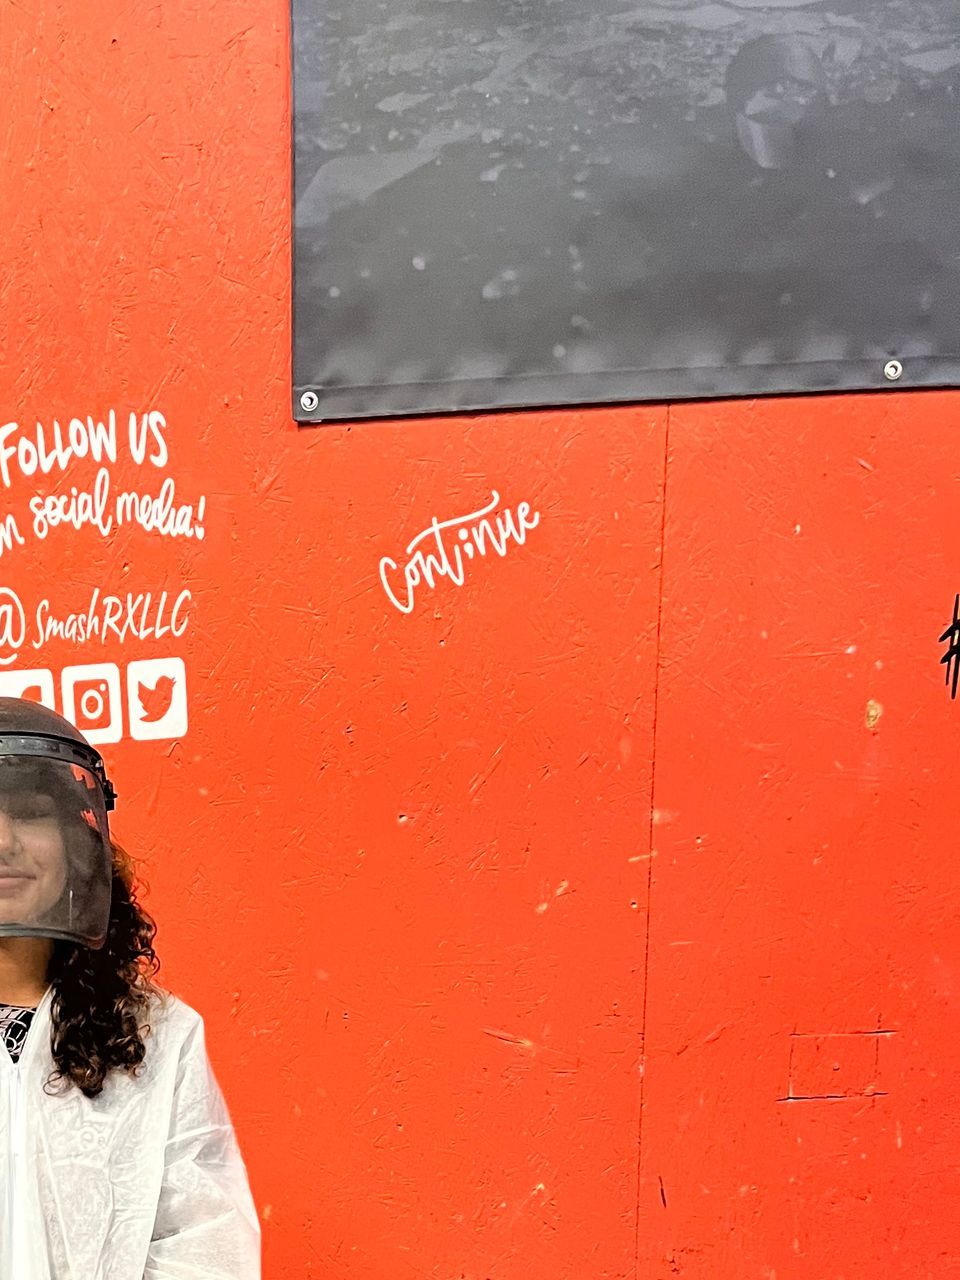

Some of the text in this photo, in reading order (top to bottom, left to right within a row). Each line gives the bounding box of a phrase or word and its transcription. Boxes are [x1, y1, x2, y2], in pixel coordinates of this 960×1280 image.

[128, 409, 169, 468] US
[29, 467, 114, 540] social
[116, 476, 207, 541] media!
